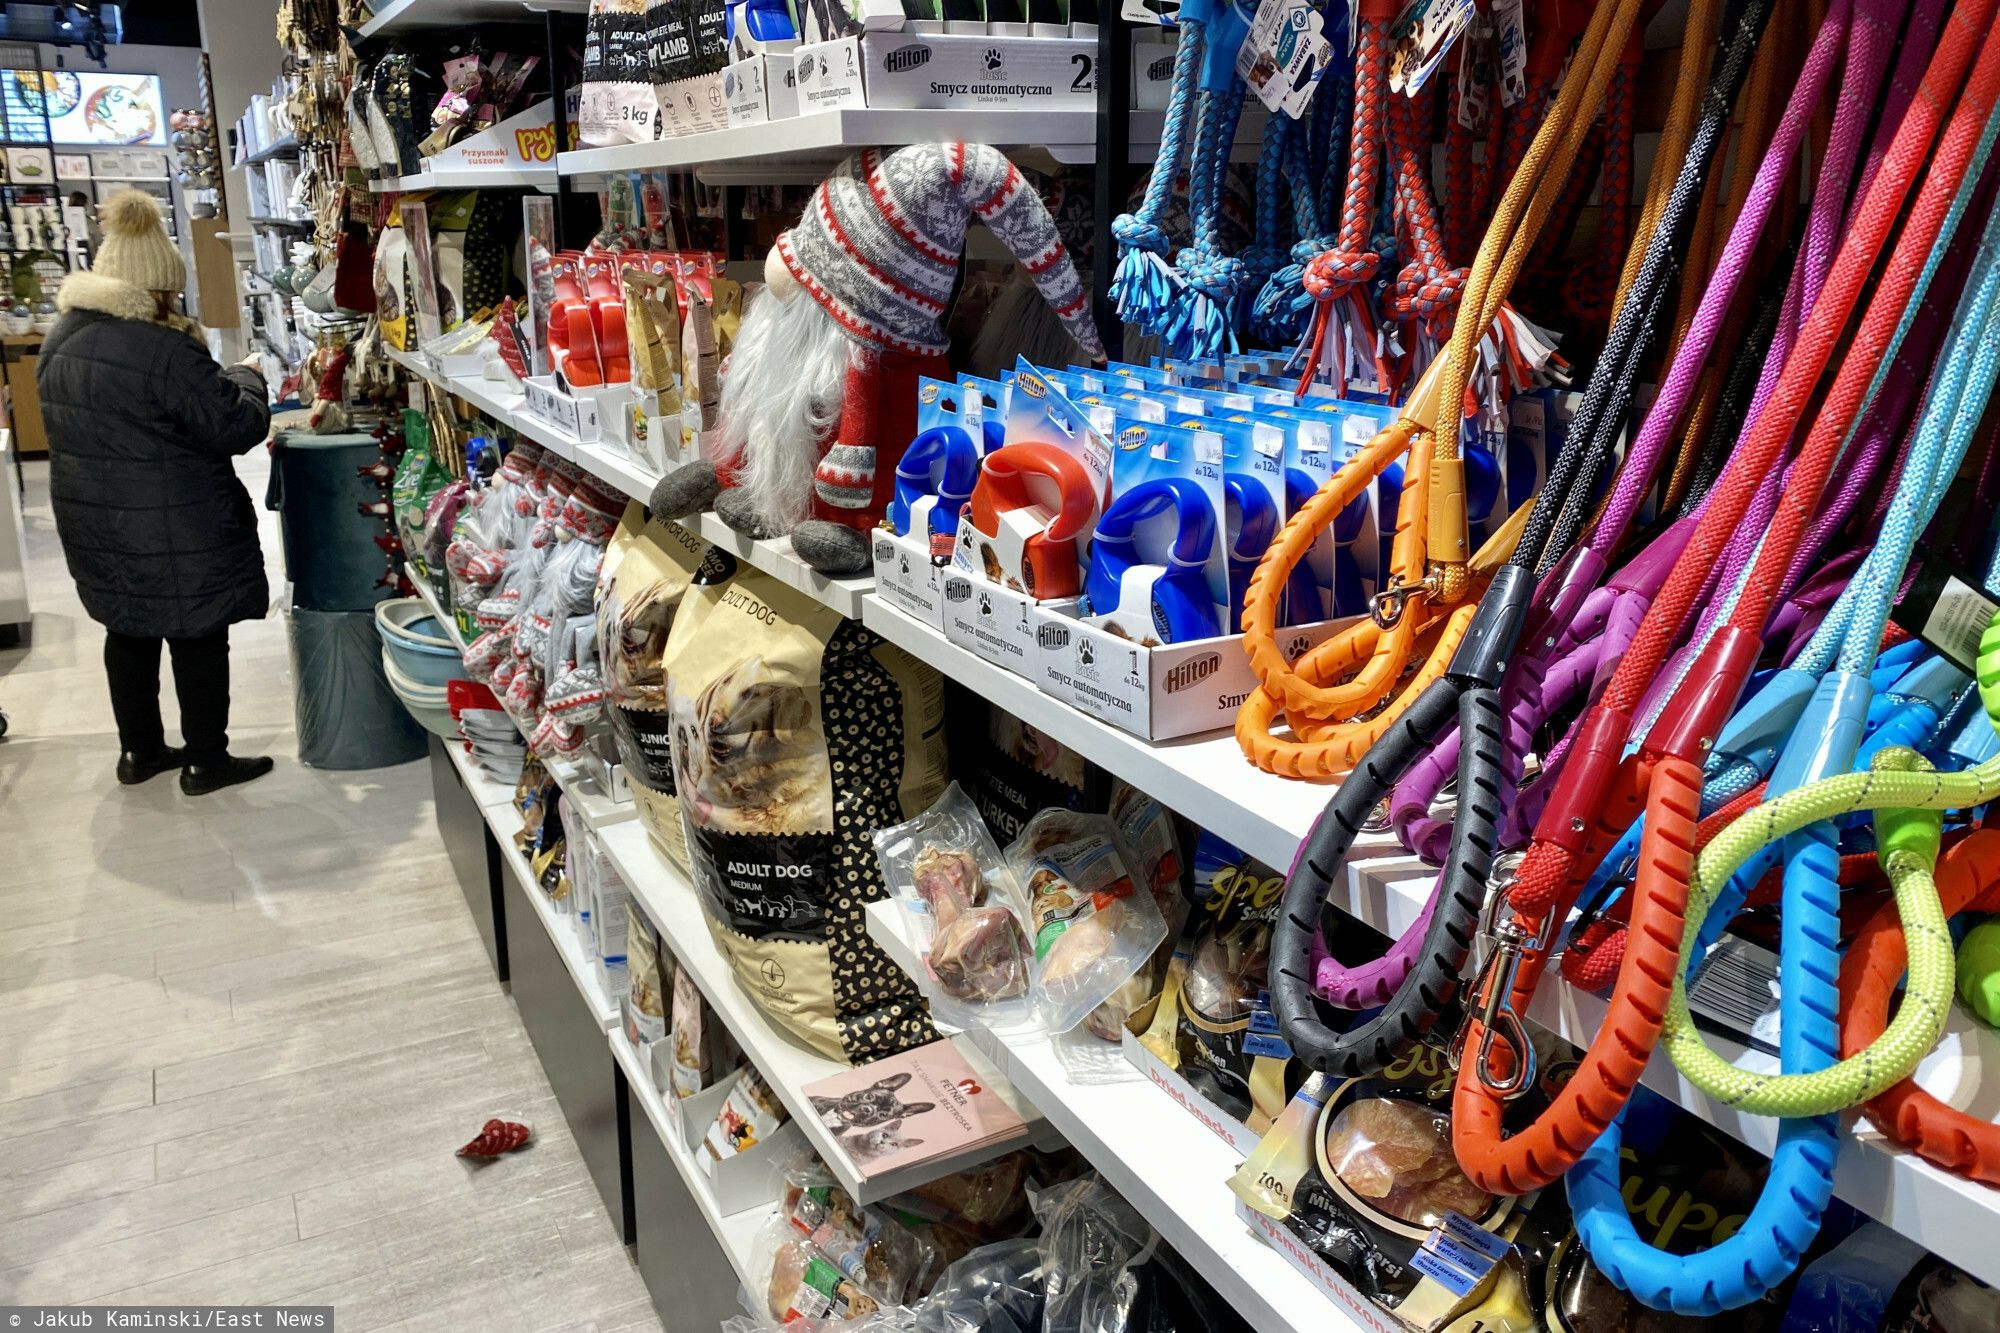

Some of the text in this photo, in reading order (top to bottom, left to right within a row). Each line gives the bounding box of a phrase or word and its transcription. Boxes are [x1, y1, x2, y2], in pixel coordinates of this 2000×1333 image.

[667, 21, 684, 32] MEAL
[698, 11, 725, 25] ADULT
[610, 31, 647, 41] ADULT DO
[700, 28, 716, 37] LARGE
[659, 37, 689, 60] LAMB
[845, 46, 853, 65] 2
[1289, 37, 1312, 75] ZABAWKA
[887, 47, 931, 73] Hilton
[1150, 60, 1175, 81] Hilt
[1070, 54, 1092, 88] 2
[930, 81, 1053, 100] Smycz automatyczna
[622, 106, 629, 120] 3
[632, 105, 648, 126] kg
[461, 149, 509, 158] Przysmaki
[1019, 372, 1046, 398] Hilton
[1120, 430, 1147, 449] Hilton
[1195, 465, 1219, 481] do 12kg
[1254, 460, 1280, 475] do 12kg
[1301, 456, 1326, 470] do 12kg
[679, 531, 701, 553] DOG
[875, 542, 895, 561] Hilton
[881, 576, 933, 611] Smycz automatyczna
[946, 580, 972, 600] Hilton
[721, 590, 778, 626] DULT DOG
[954, 617, 1024, 657] Smycz automatyczna
[1038, 625, 1070, 647] Hilton
[1129, 650, 1139, 676] 1
[1130, 676, 1145, 692] 12kg
[1167, 653, 1220, 695] Hilton
[1047, 666, 1133, 713] Smycz automatyczna
[640, 733, 671, 746] JUNIO
[1004, 785, 1028, 810] MEAL
[982, 796, 1025, 841] URKEY
[727, 861, 813, 879] ADULT DOG
[730, 879, 762, 892] MEDIUM
[940, 1078, 968, 1107] PETNER
[940, 1098, 973, 1132] BEZTROSKA
[1151, 1067, 1187, 1107] Dried
[1188, 1102, 1236, 1146] snacks
[1258, 1171, 1289, 1203] 100g
[1315, 1218, 1327, 1231] z
[1451, 1214, 1473, 1231] Wysoka
[1421, 1254, 1438, 1267] Niska
